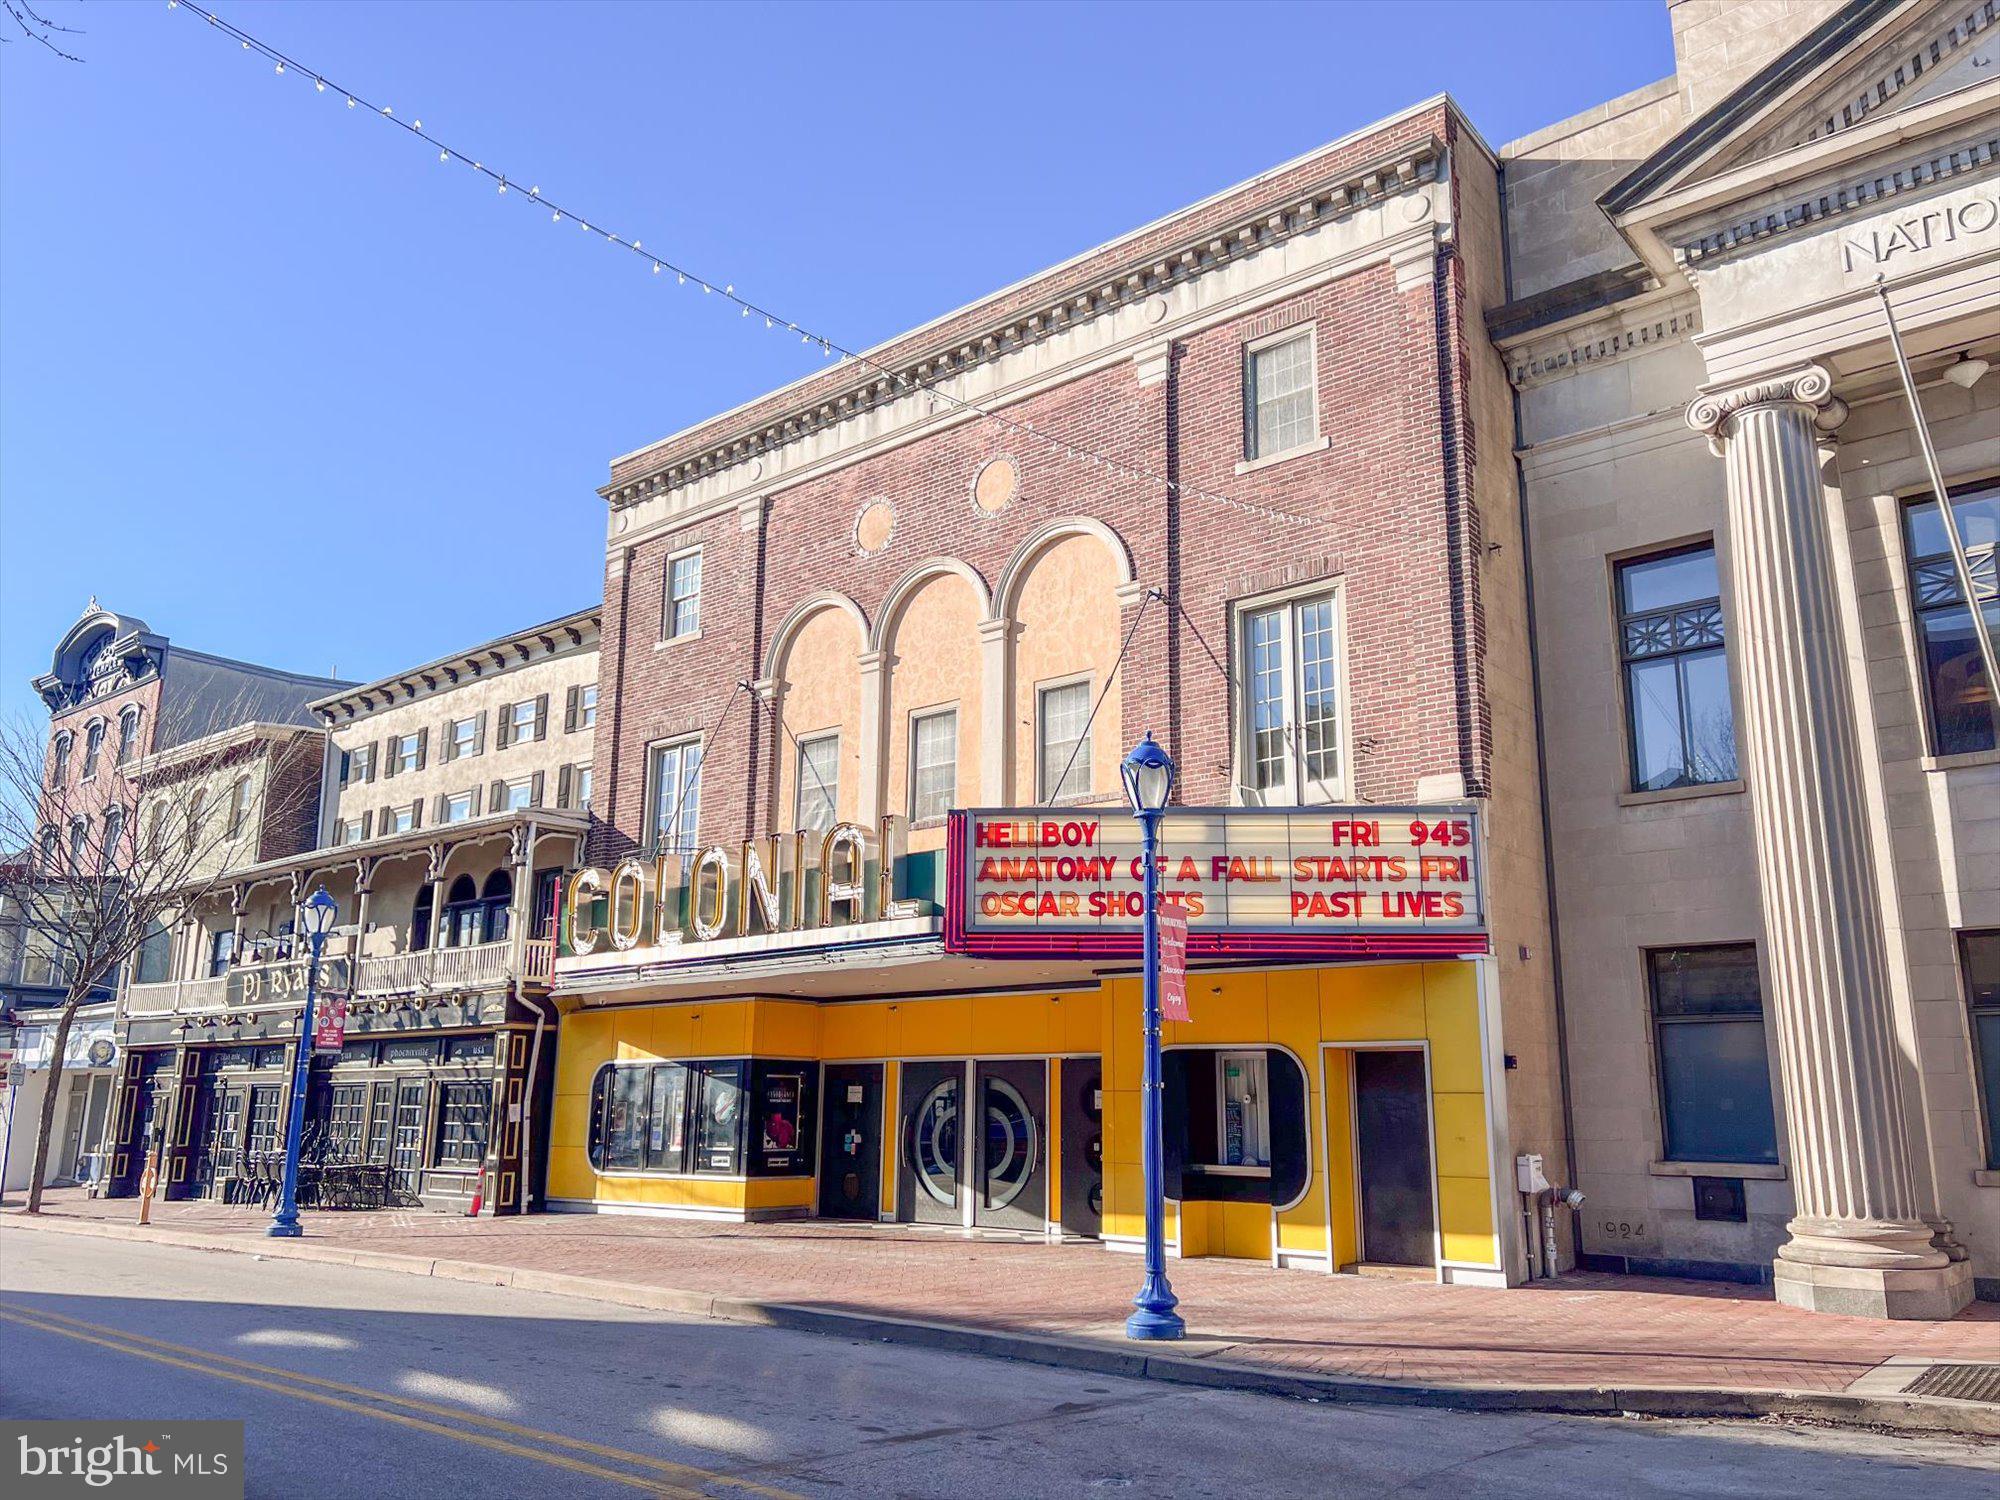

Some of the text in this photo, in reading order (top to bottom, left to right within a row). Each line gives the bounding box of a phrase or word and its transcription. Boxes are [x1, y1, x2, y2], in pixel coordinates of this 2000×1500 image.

[1844, 198, 2000, 273] NATIO
[976, 820, 1471, 848] HELLBOY FRI 945
[977, 855, 1117, 882] ANATOMY
[1176, 856, 1201, 882] A
[1211, 855, 1281, 882] FALL
[1294, 855, 1408, 882] STARTS
[1420, 855, 1469, 882] FRI
[567, 814, 920, 956] COLONIAL
[980, 890, 1080, 917] OSCAR
[1291, 890, 1367, 918] PAST
[1382, 890, 1466, 918] LIVES
[270, 963, 330, 999] Ryas
[1597, 1220, 1645, 1241] 1924
